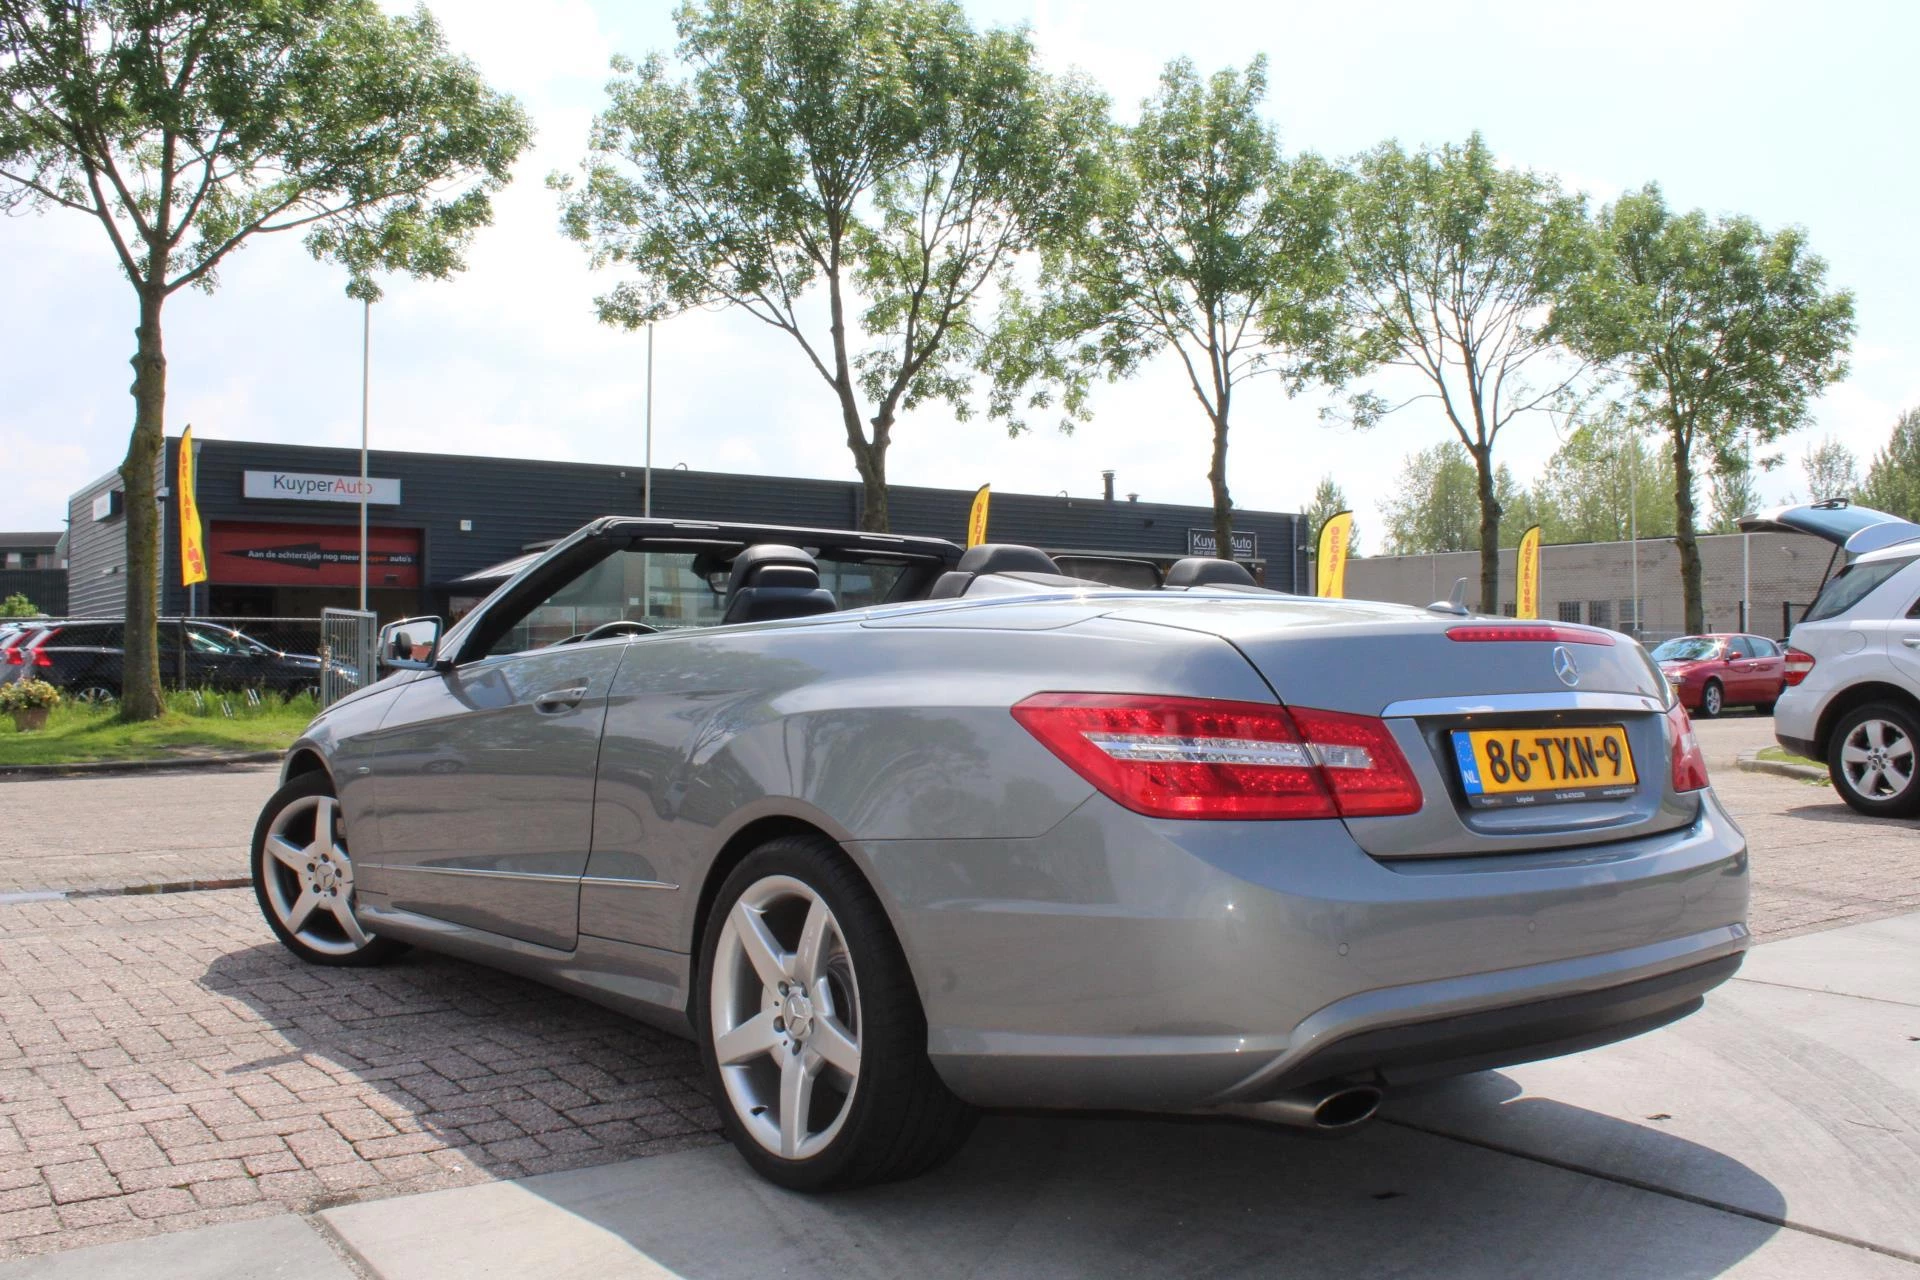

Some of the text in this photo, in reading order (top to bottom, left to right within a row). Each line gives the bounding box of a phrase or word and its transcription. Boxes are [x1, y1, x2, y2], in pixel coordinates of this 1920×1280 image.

[1193, 533, 1252, 549] KuyAuto
[248, 550, 264, 558] Aan
[266, 550, 276, 558] de
[278, 551, 322, 561] achterzijde
[323, 553, 338, 562] nog
[390, 555, 412, 563] auto's
[1486, 735, 1622, 784] 86-TXN-9
[1463, 769, 1480, 784] NL
